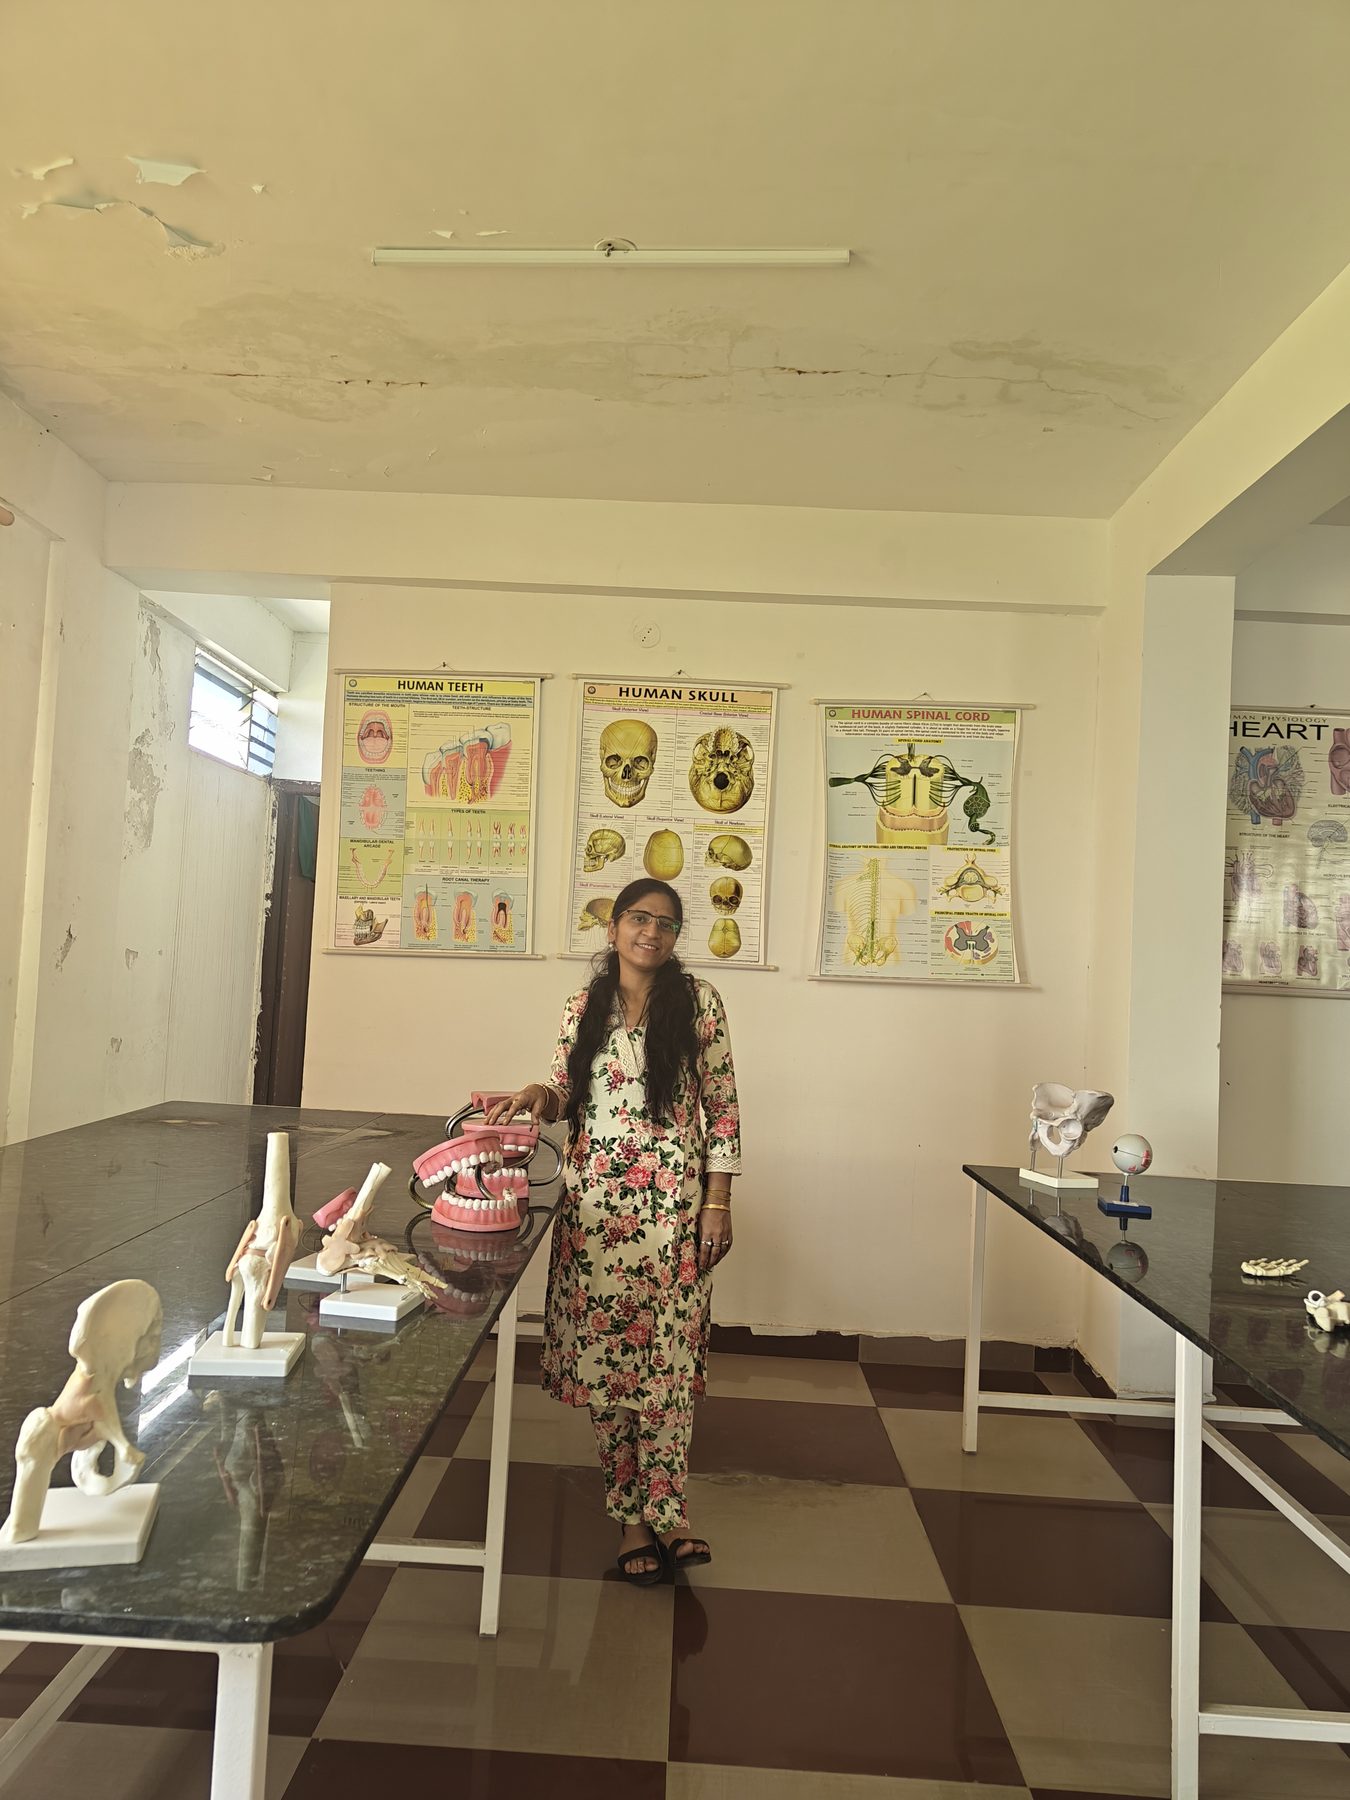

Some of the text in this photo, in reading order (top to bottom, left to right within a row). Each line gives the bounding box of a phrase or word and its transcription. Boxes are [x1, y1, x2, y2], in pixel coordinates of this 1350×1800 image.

[398, 680, 484, 692] HUMAN TEETH
[618, 686, 738, 703] HUMAN SKULL
[852, 709, 990, 722] HUMAN SPINAL CORD
